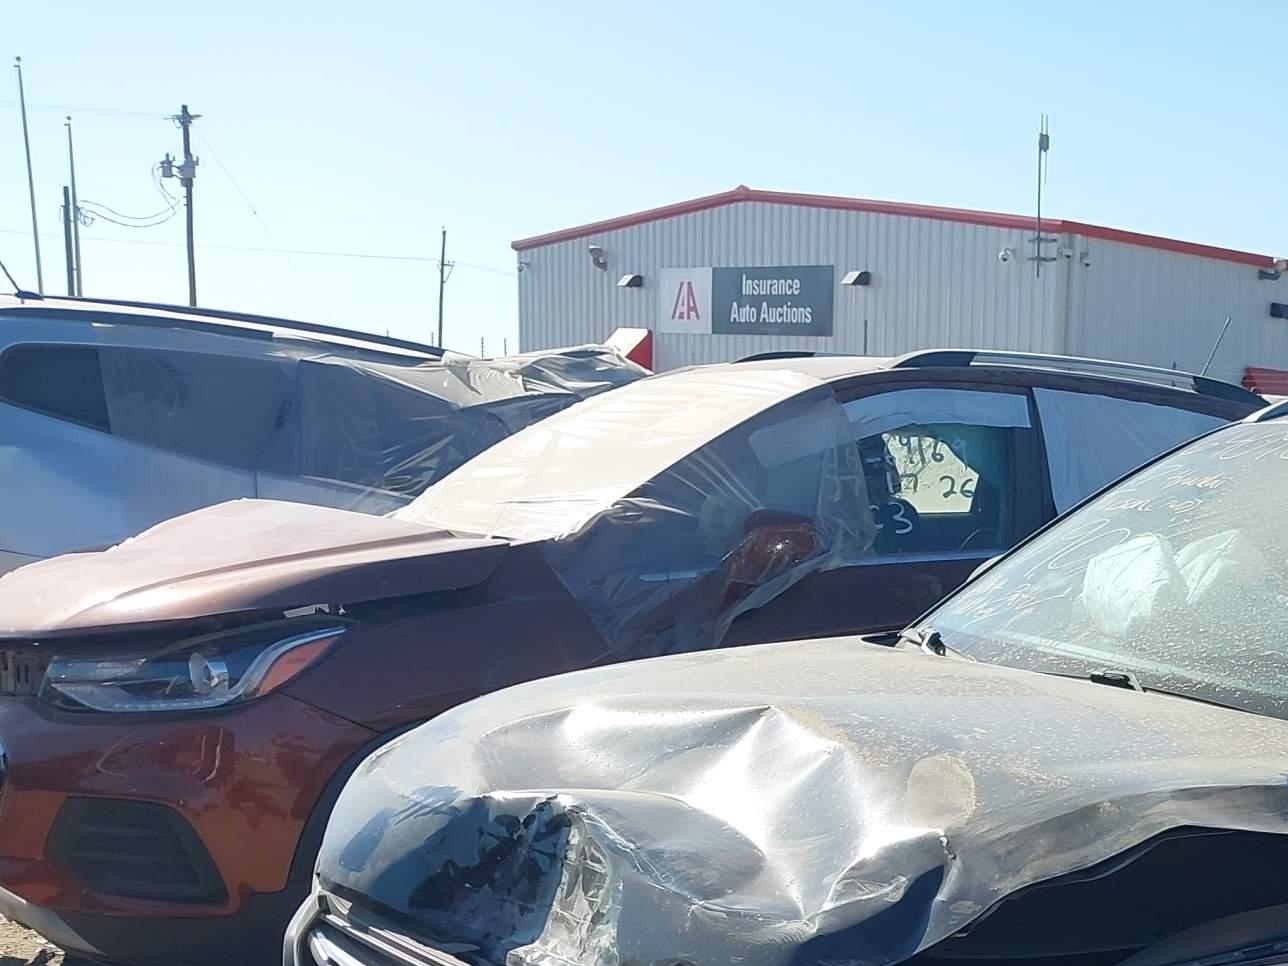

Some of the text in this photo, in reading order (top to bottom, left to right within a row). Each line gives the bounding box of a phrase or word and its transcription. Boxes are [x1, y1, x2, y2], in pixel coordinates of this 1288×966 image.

[742, 274, 801, 296] Insurance
[730, 302, 813, 324] Auto Auctions
